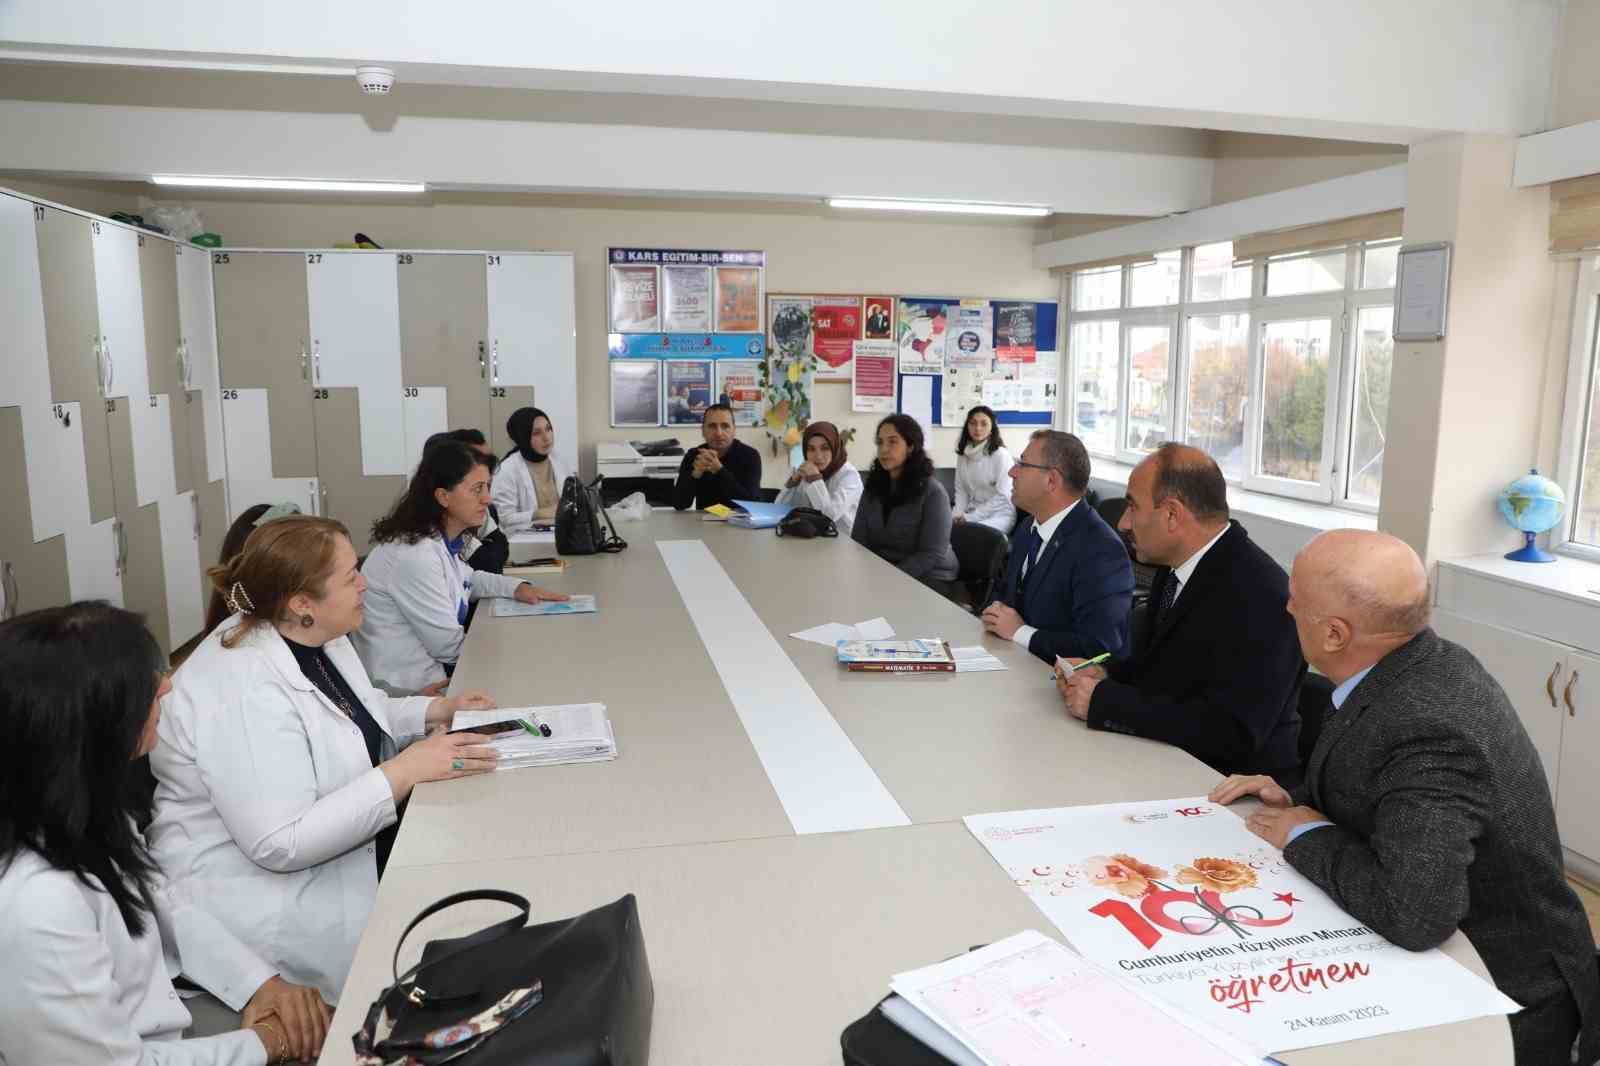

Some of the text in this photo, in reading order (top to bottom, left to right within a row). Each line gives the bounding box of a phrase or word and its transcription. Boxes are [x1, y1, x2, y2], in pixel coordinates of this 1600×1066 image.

[35, 207, 45, 221] 17
[214, 254, 230, 264] 25
[308, 254, 322, 264] 27
[398, 254, 413, 264] 29
[488, 255, 501, 265] 31
[628, 251, 659, 262] KARS
[223, 390, 238, 400] 26
[314, 390, 329, 399] 28
[404, 388, 418, 398] 30
[492, 388, 506, 398] 32
[1118, 945, 1234, 971] Cumhuriyetin
[1232, 933, 1314, 953] Yüzyılının
[1207, 957, 1371, 1014] öğretmen
[1284, 1018, 1308, 1032] 24
[1349, 1004, 1390, 1021] 2023
